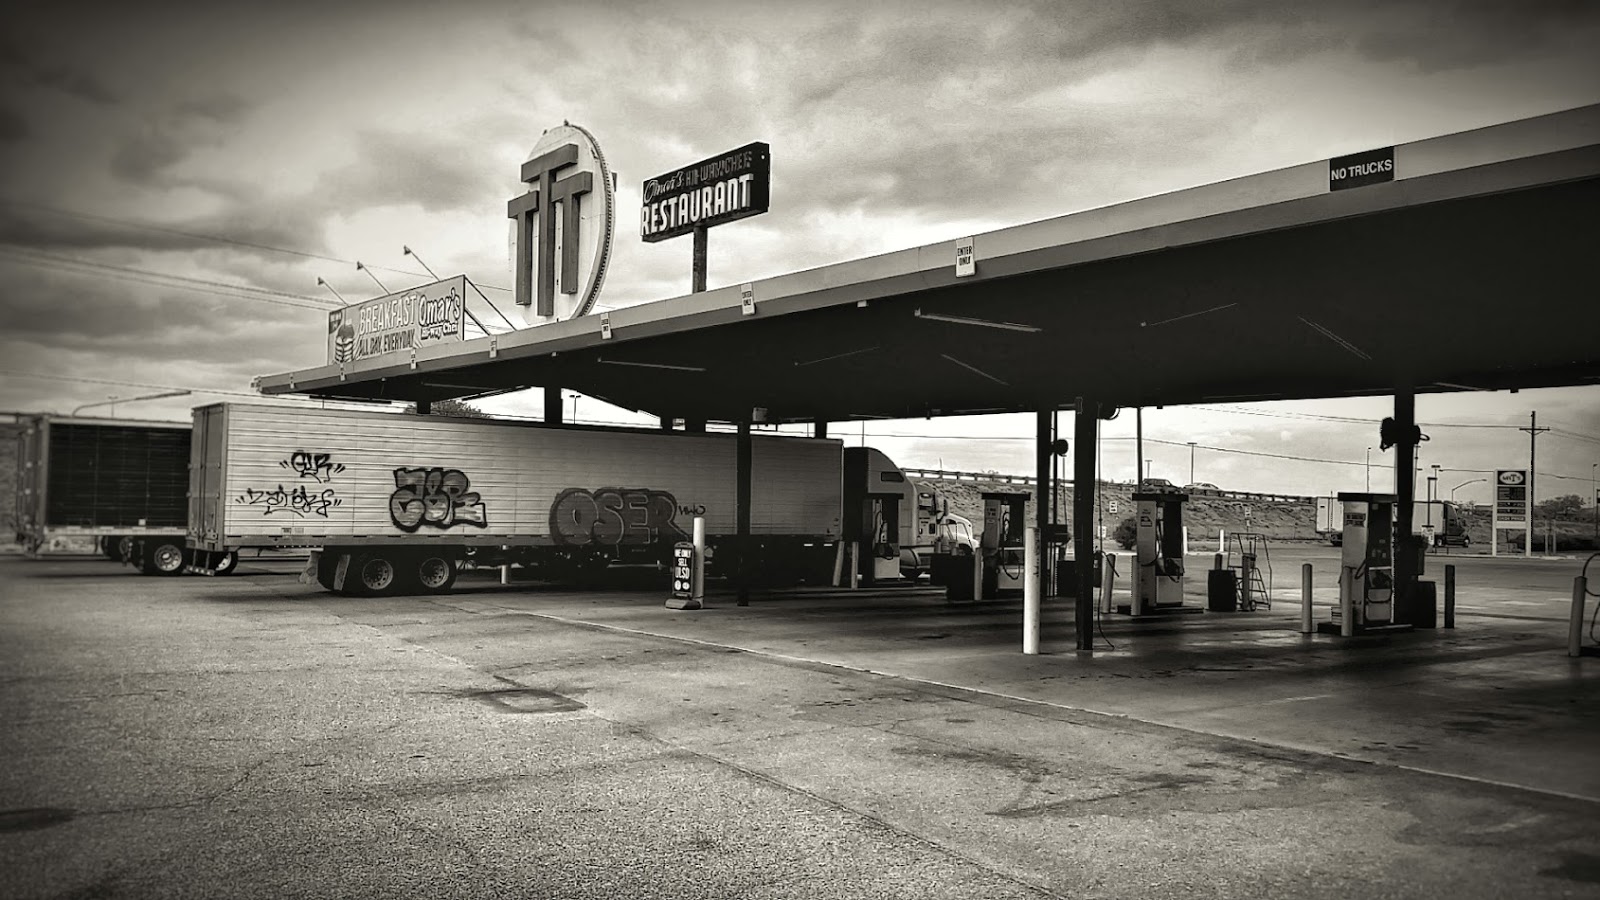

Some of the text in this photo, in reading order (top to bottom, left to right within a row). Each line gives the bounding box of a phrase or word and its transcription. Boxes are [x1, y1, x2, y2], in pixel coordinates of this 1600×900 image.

[1331, 159, 1393, 181] NO TRUCKS
[643, 171, 685, 204] Omar's
[641, 173, 753, 236] RESTAURANT
[957, 245, 973, 257] ENTER
[959, 255, 971, 266] ONLY
[359, 294, 417, 336] BREAKFAST
[418, 287, 461, 327] Omar's
[383, 328, 416, 353] EVERYDAY
[682, 549, 691, 558] ONLY
